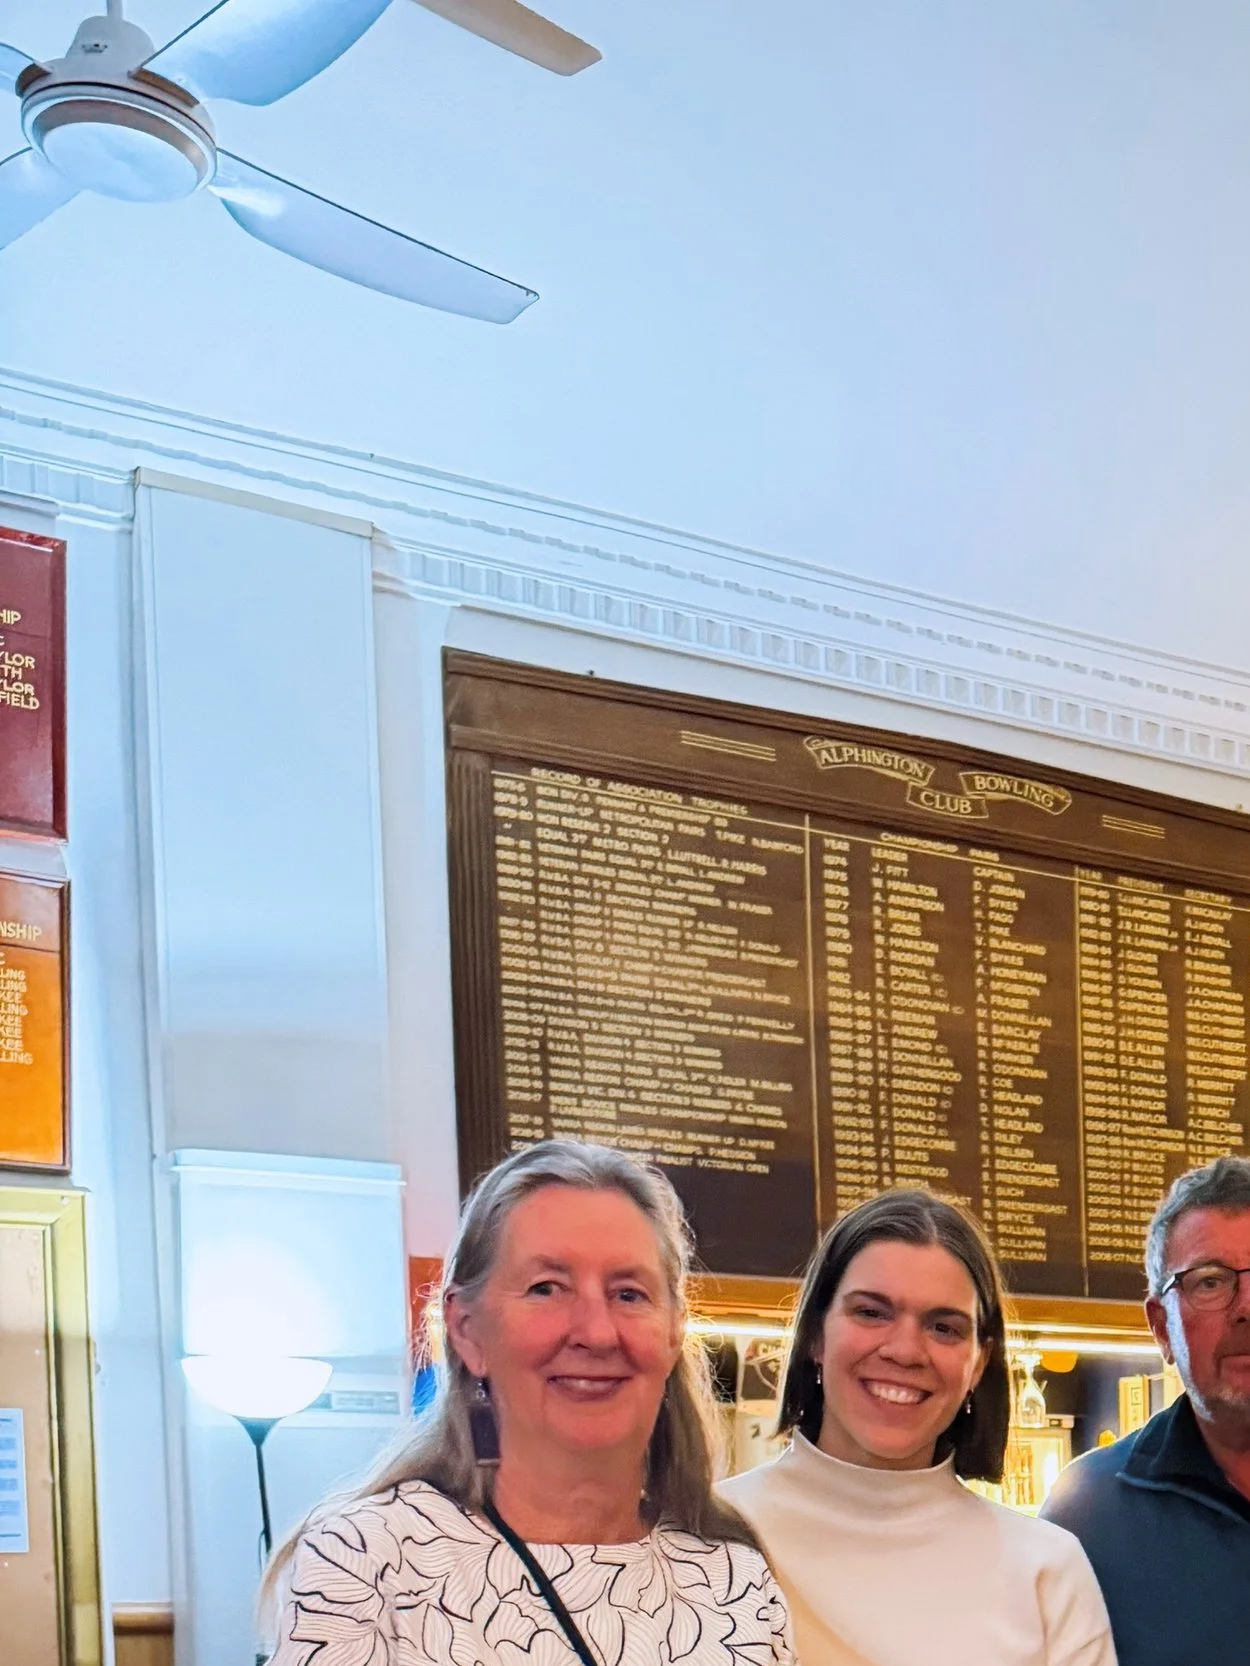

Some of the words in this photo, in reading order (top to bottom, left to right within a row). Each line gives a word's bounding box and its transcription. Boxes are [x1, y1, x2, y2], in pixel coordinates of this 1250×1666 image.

[820, 746, 926, 778] ALPHINGTON
[974, 774, 1055, 809] BOWLING
[531, 768, 582, 784] RECORD
[586, 778, 601, 788] OF
[608, 782, 683, 803] ASSOCIATION
[691, 797, 748, 814] TROPHIES
[920, 790, 973, 815] CLUB
[600, 811, 674, 831] METROPOLITAN
[536, 828, 569, 842] EQUAL
[880, 832, 959, 853] CHAMPIONSHIP
[969, 849, 1000, 862] PAIRS
[824, 839, 850, 851] YEAR
[871, 848, 908, 862] LEADER
[973, 867, 1015, 882] CAPTAIN
[887, 880, 938, 897] HAMILTON
[988, 899, 1019, 911] SYKES
[888, 895, 945, 912] ANDERSON
[889, 937, 939, 953] HAMILTON
[890, 924, 922, 936] JONES
[989, 940, 1047, 956] BLANCHARD
[990, 968, 1047, 984] HONEYMAN
[890, 981, 931, 995] CARTER
[991, 1011, 1052, 1027] DONNELLAN
[892, 1025, 938, 1039] ANDREW
[992, 1025, 1041, 1040] BARCLAY
[892, 1052, 954, 1068] DONNELLAN
[992, 1052, 1034, 1065] PARKER
[892, 1065, 962, 1082] GATHERGOOD
[992, 1078, 1013, 1089] COE
[1130, 1071, 1168, 1084] DONALD
[993, 1092, 1043, 1105] HEADLAND
[1130, 1086, 1168, 1098] DONALD
[892, 1093, 938, 1107] DONALD
[994, 1105, 1030, 1117] NOLAN
[892, 1108, 936, 1121] DONALD
[994, 1119, 1044, 1133] HEADLAND
[893, 1122, 937, 1135] DONALD
[994, 1133, 1024, 1144] RILEY
[894, 1136, 956, 1151] EDGECOMBE
[697, 1159, 744, 1171] VICTORIAN
[746, 1164, 769, 1174] OPEN
[995, 1160, 1058, 1174] EDGECOMBE
[996, 1187, 1025, 1197] SUCH
[997, 1212, 1034, 1224] BRYCE
[997, 1225, 1046, 1237] SULLIVAN
[998, 1238, 1046, 1249] SULLIVAN
[998, 1250, 1047, 1261] SULLIVAN
